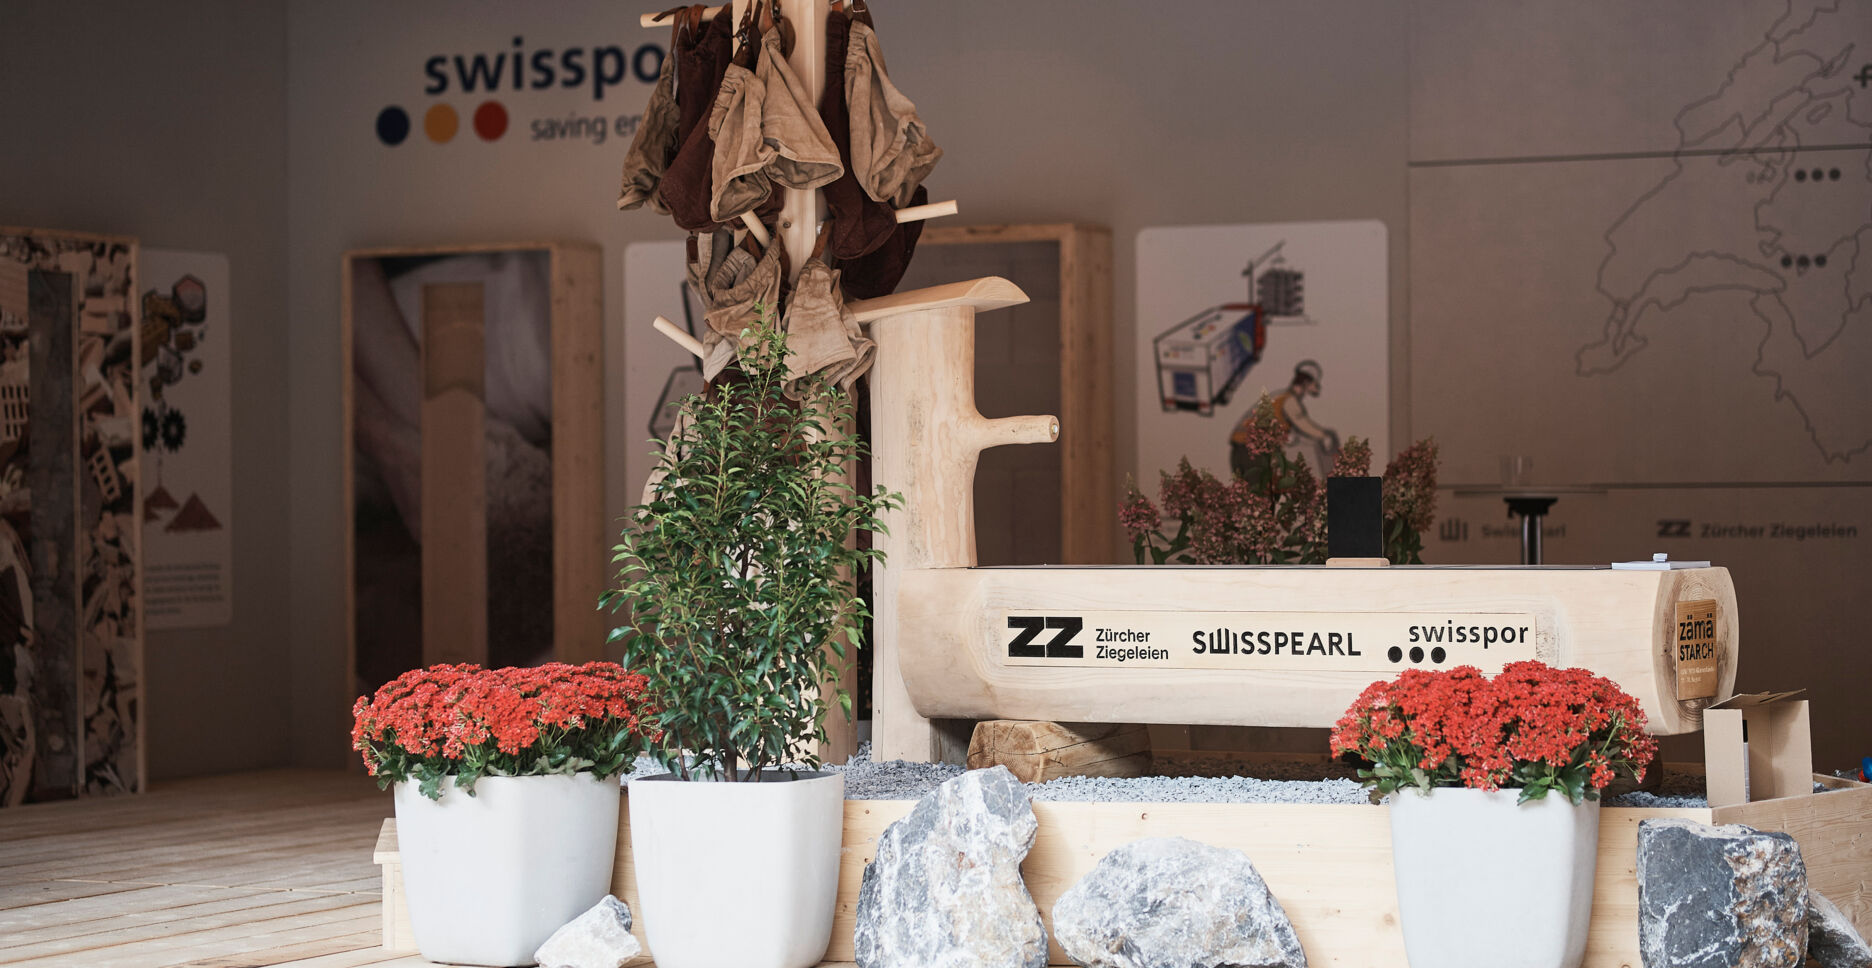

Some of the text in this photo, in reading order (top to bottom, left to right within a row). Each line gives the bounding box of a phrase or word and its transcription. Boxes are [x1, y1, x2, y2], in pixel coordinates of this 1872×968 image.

[425, 36, 665, 100] swisspo
[530, 110, 608, 144] saving
[1658, 521, 1858, 542] ZZ Zürcher Ziegeleien
[1008, 616, 1084, 658] ZZ
[1095, 628, 1151, 643] Zürcher
[1408, 619, 1529, 649] swisspor
[1679, 613, 1714, 641] zämä
[1096, 645, 1169, 662] Ziegeleien
[1192, 627, 1362, 656] SWISSPEARL
[1679, 642, 1714, 662] STARCH
